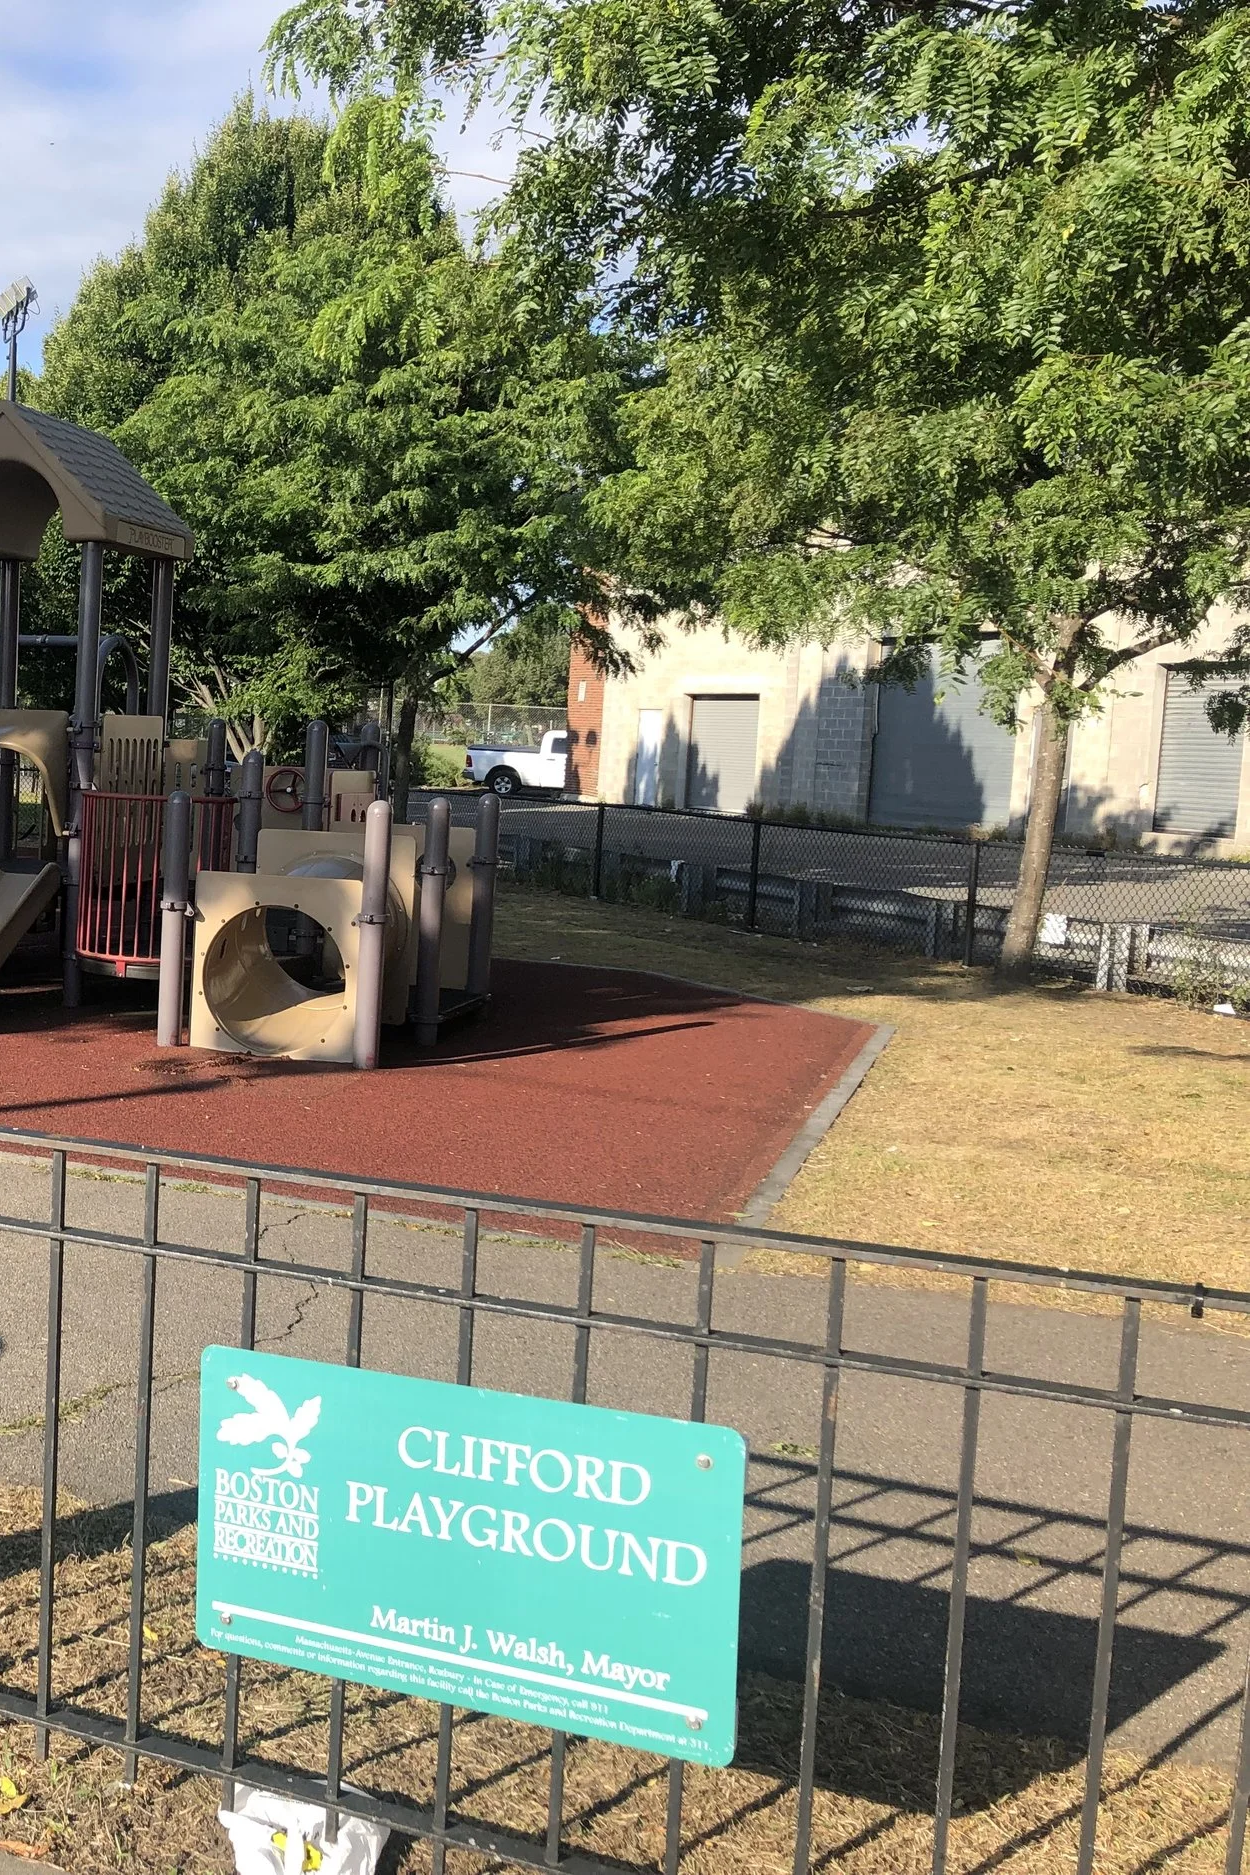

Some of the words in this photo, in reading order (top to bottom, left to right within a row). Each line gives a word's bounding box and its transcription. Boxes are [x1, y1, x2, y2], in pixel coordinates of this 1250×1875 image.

[215, 1467, 319, 1514] BOSTON
[398, 1426, 651, 1506] CLIFFORD
[214, 1500, 271, 1530] PARKS
[275, 1512, 319, 1540] AND
[214, 1527, 318, 1568] RECREATION
[345, 1480, 707, 1587] PLAYGROUND
[210, 1628, 223, 1639] For
[224, 1633, 263, 1648] questions,
[264, 1642, 305, 1656] comments
[318, 1652, 365, 1671] information
[367, 1666, 407, 1681] regarding
[409, 1674, 425, 1684] this
[426, 1677, 456, 1692] facility
[458, 1686, 474, 1696] call
[475, 1689, 490, 1699] the
[492, 1692, 521, 1706] Boston
[522, 1699, 547, 1712] Parks
[549, 1705, 566, 1717] and
[568, 1710, 617, 1728] Recreation
[619, 1721, 675, 1741] Department
[295, 1635, 352, 1655] Massachusetts
[355, 1649, 385, 1663] Avenue
[428, 1665, 464, 1682] Roxbury
[473, 1676, 482, 1685] In
[484, 1679, 506, 1690] Case
[507, 1684, 517, 1693] of
[571, 1699, 589, 1709] call
[590, 1702, 609, 1714] 911
[370, 1605, 456, 1645] Martin
[459, 1624, 478, 1653] J.
[486, 1629, 574, 1676] Walsh,
[581, 1650, 671, 1691] Mayor
